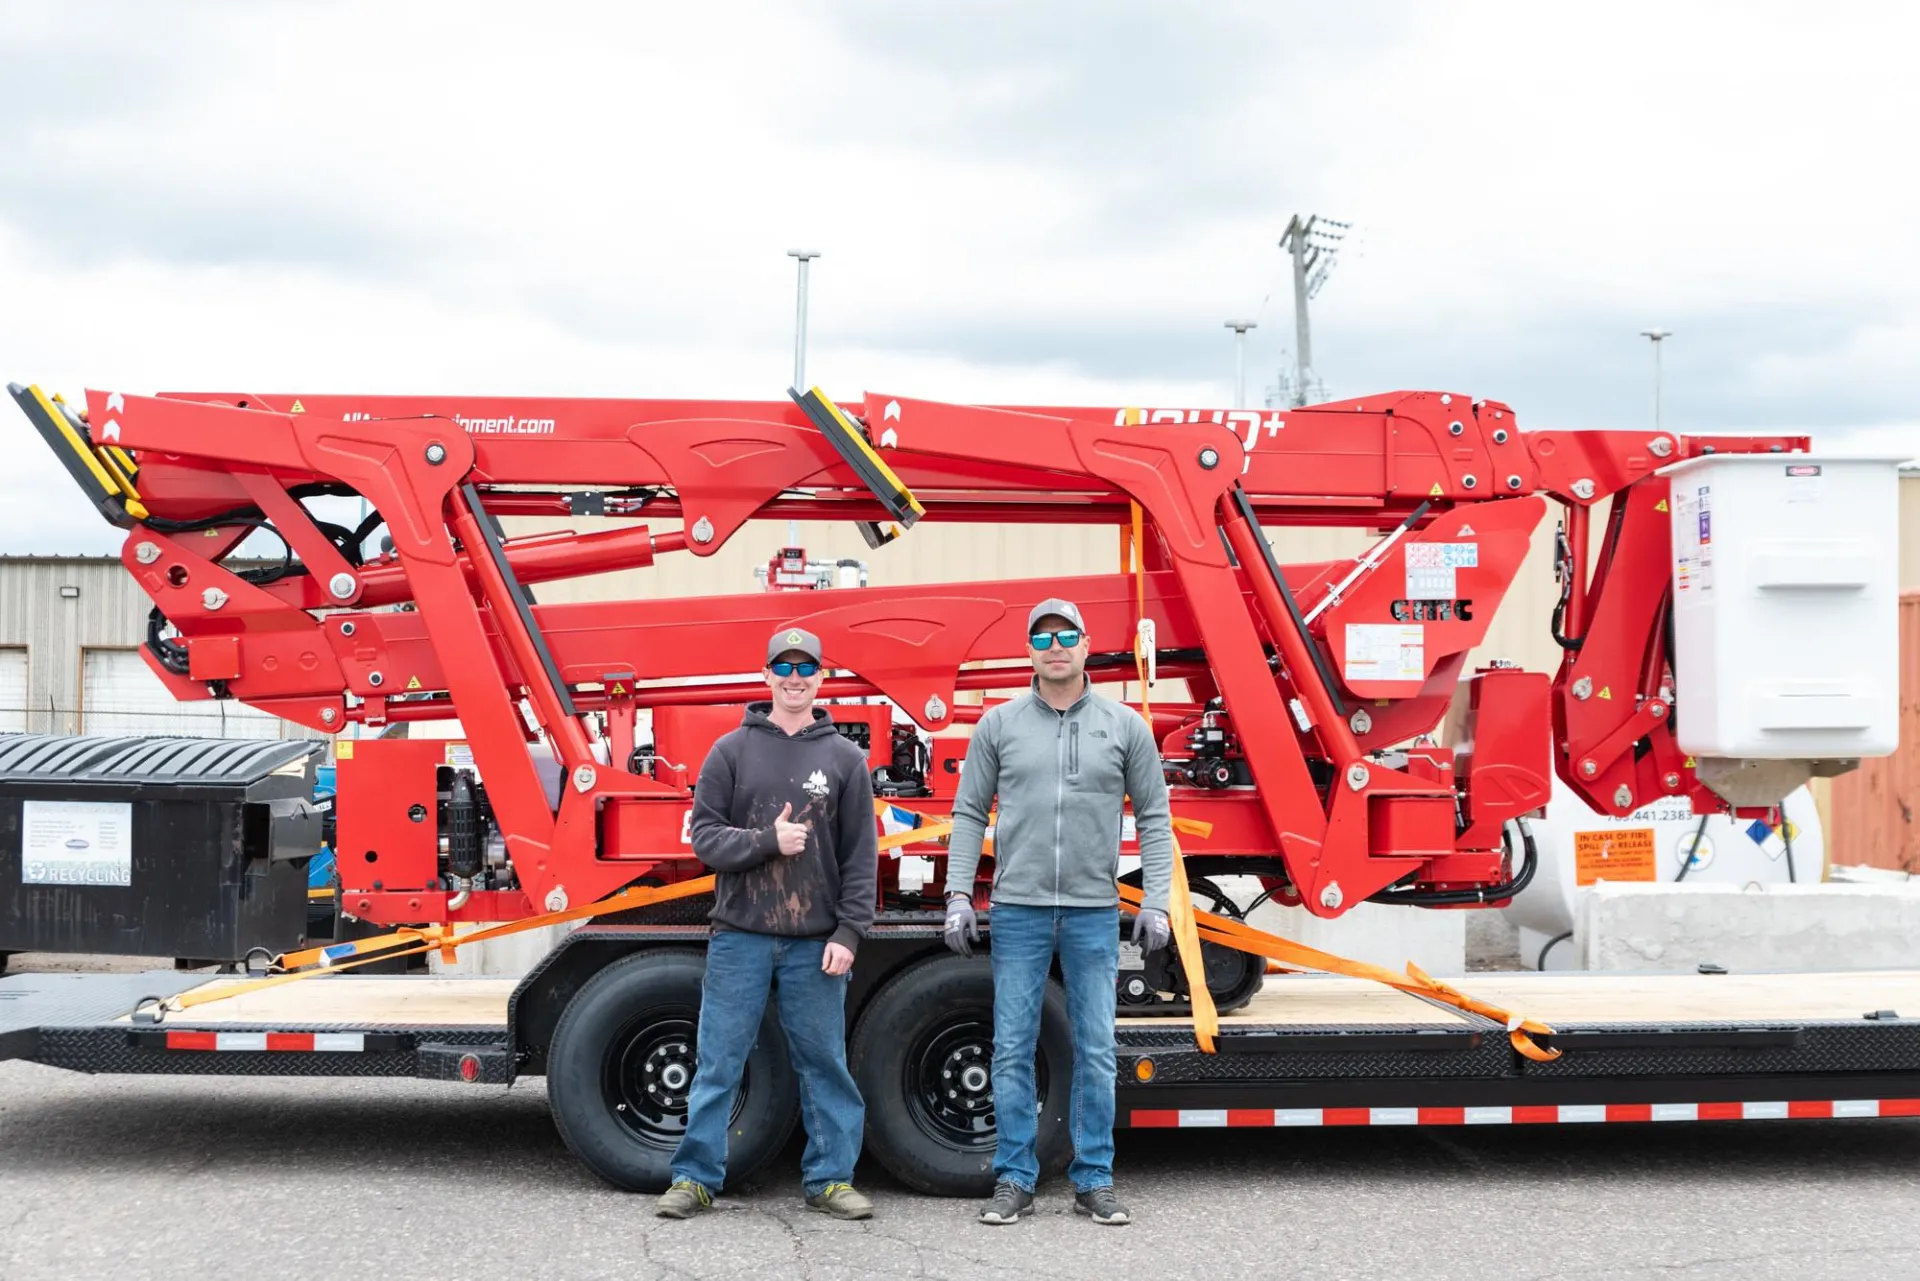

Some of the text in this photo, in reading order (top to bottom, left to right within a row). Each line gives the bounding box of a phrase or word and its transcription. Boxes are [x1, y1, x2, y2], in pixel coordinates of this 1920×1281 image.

[1608, 810, 1693, 822] .441.2383
[1580, 831, 1647, 842] IN CASE OF FIRE
[1578, 843, 1599, 851] SPILL
[1618, 840, 1652, 848] RELEASE
[50, 868, 130, 883] RECYCLING
